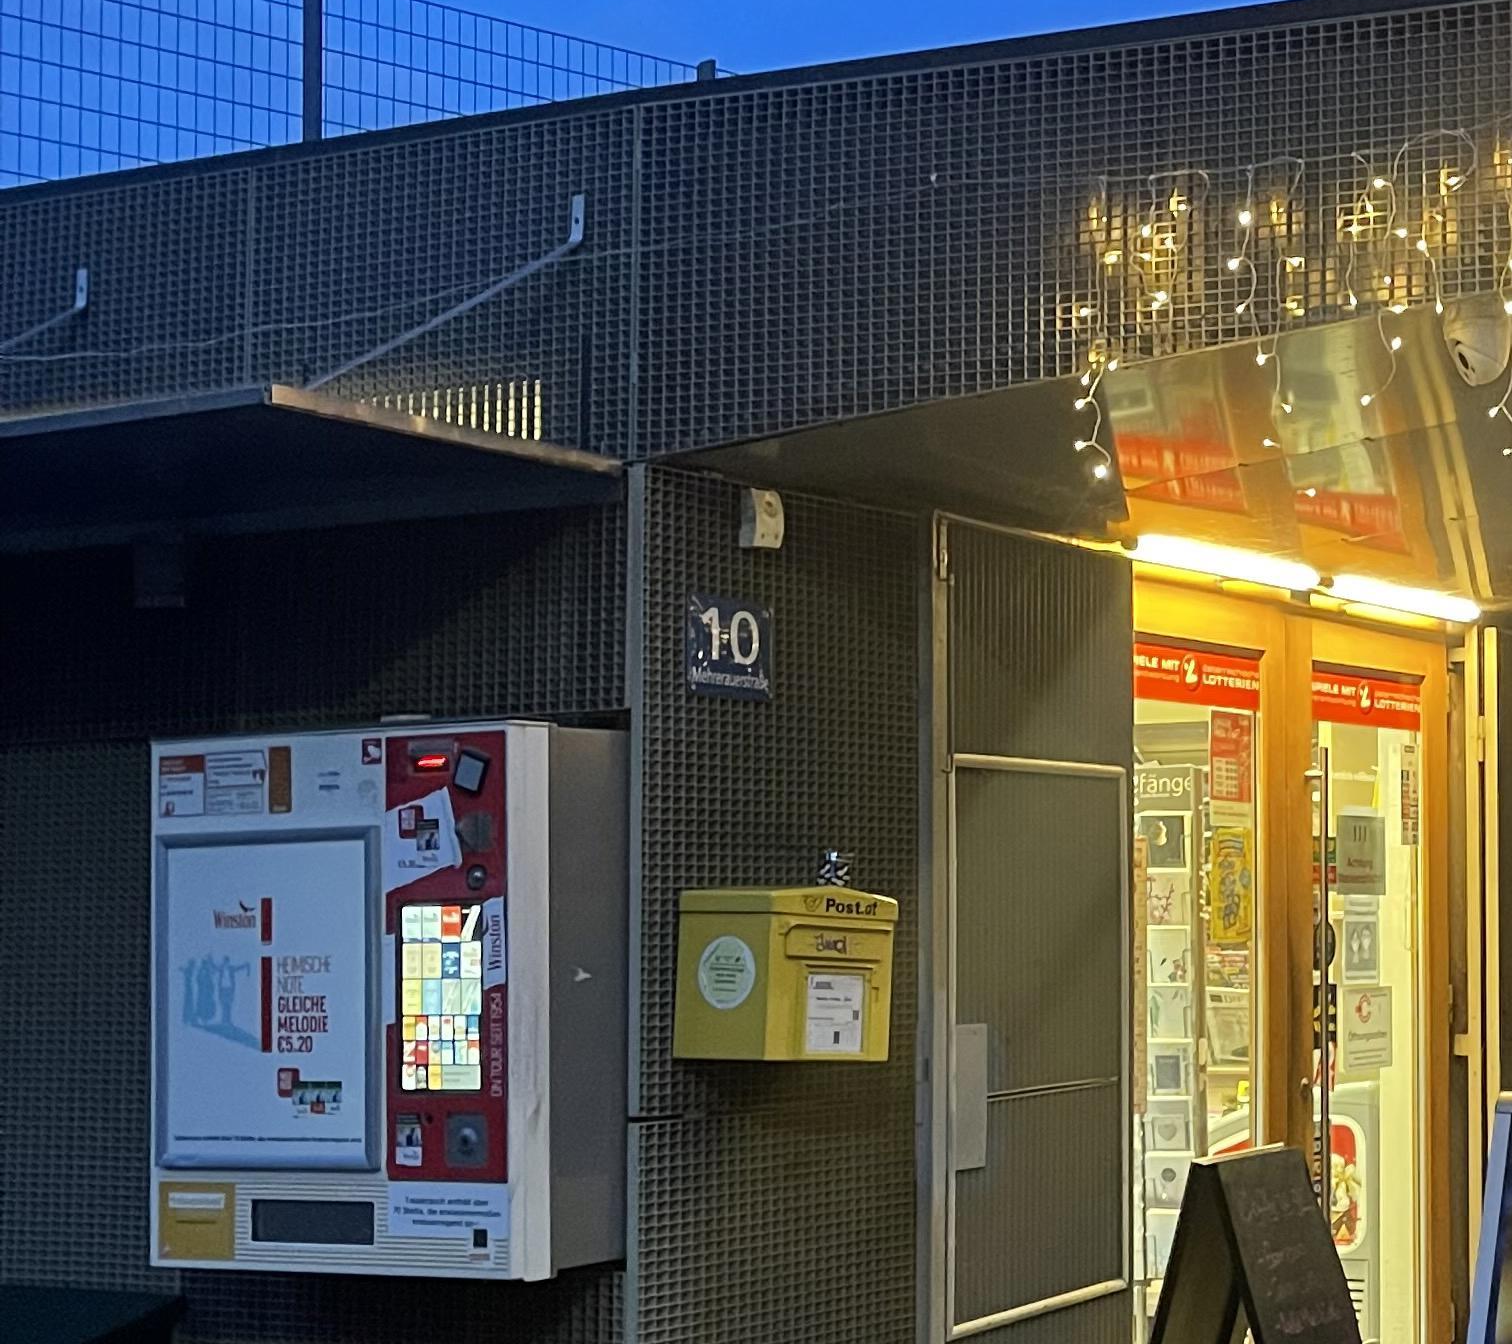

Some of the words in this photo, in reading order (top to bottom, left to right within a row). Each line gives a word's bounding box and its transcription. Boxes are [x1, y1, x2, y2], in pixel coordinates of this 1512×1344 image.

[699, 607, 760, 665] 10
[1162, 658, 1180, 671] MIT
[1202, 673, 1259, 691] LOTTERIEN
[213, 910, 256, 929] Winston
[487, 914, 503, 971] Winston
[277, 995, 327, 1014] GLEICHE
[277, 1015, 329, 1033] MELODIE
[277, 1036, 313, 1054] €5.20
